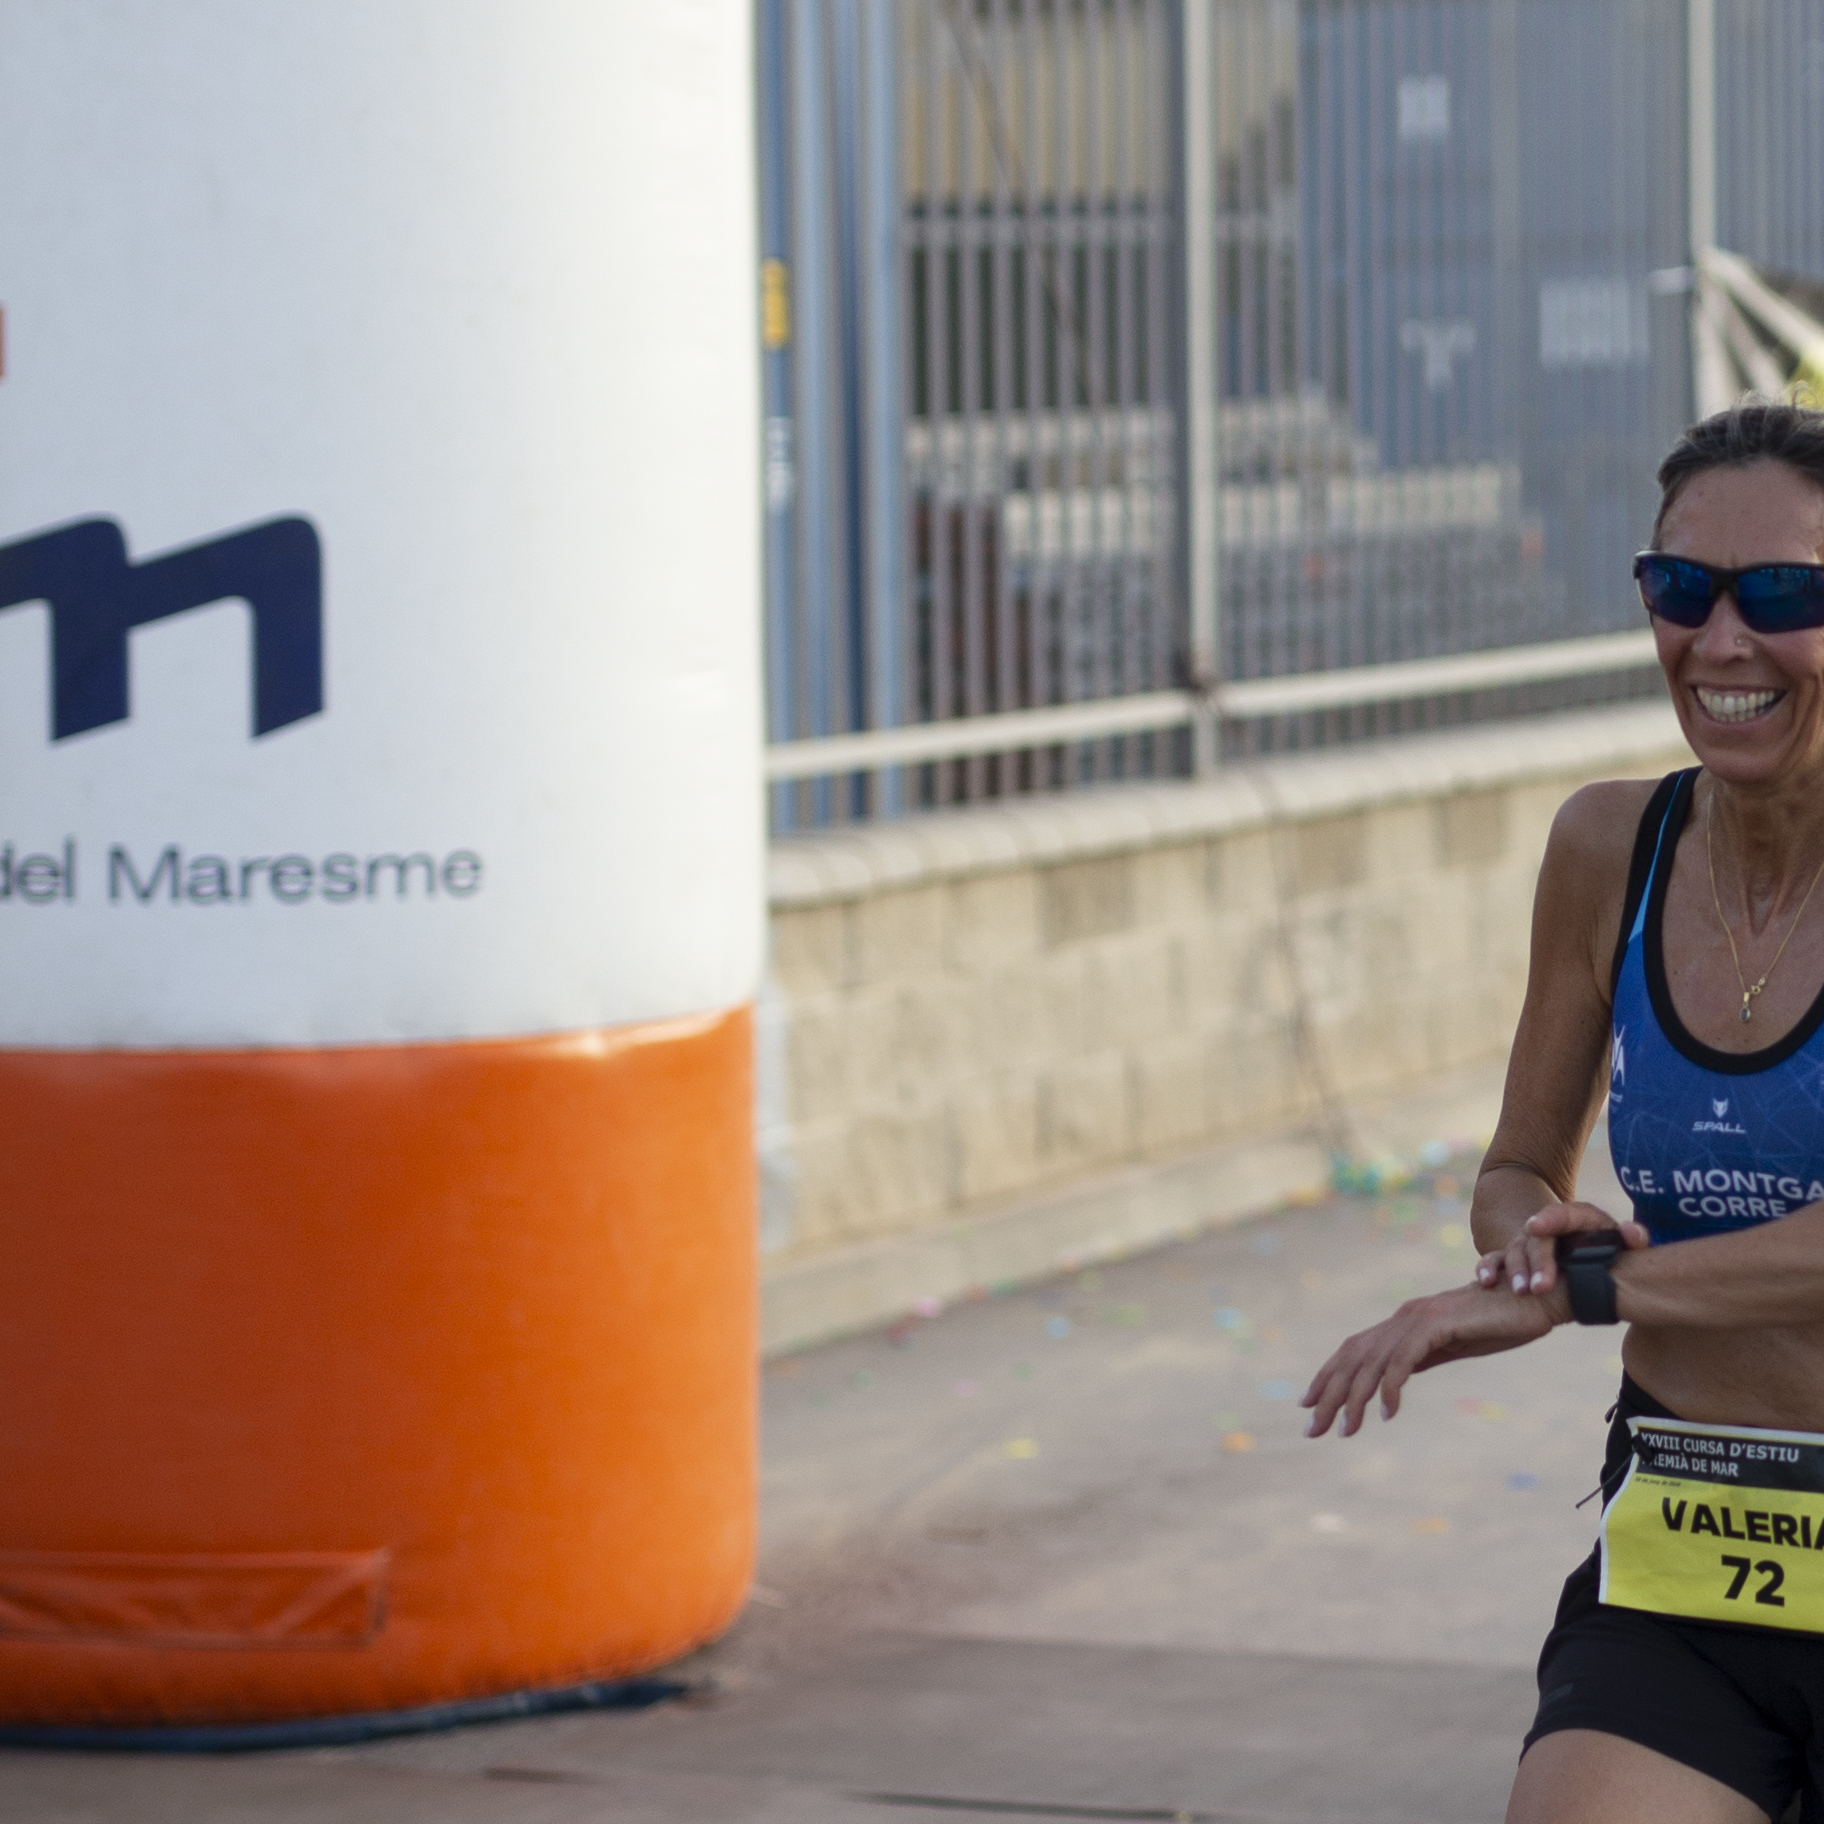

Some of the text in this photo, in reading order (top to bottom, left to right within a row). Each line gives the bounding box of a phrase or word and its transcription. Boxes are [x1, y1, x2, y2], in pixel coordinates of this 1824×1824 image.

[0, 837, 482, 905] el Maresme
[1692, 1121, 1747, 1134] SPALL
[1620, 1166, 1664, 1194] C.E.
[1683, 1437, 1725, 1456] CURSA
[1691, 1457, 1708, 1473] DE
[1711, 1460, 1739, 1477] MAR
[1721, 1554, 1786, 1607] 72
